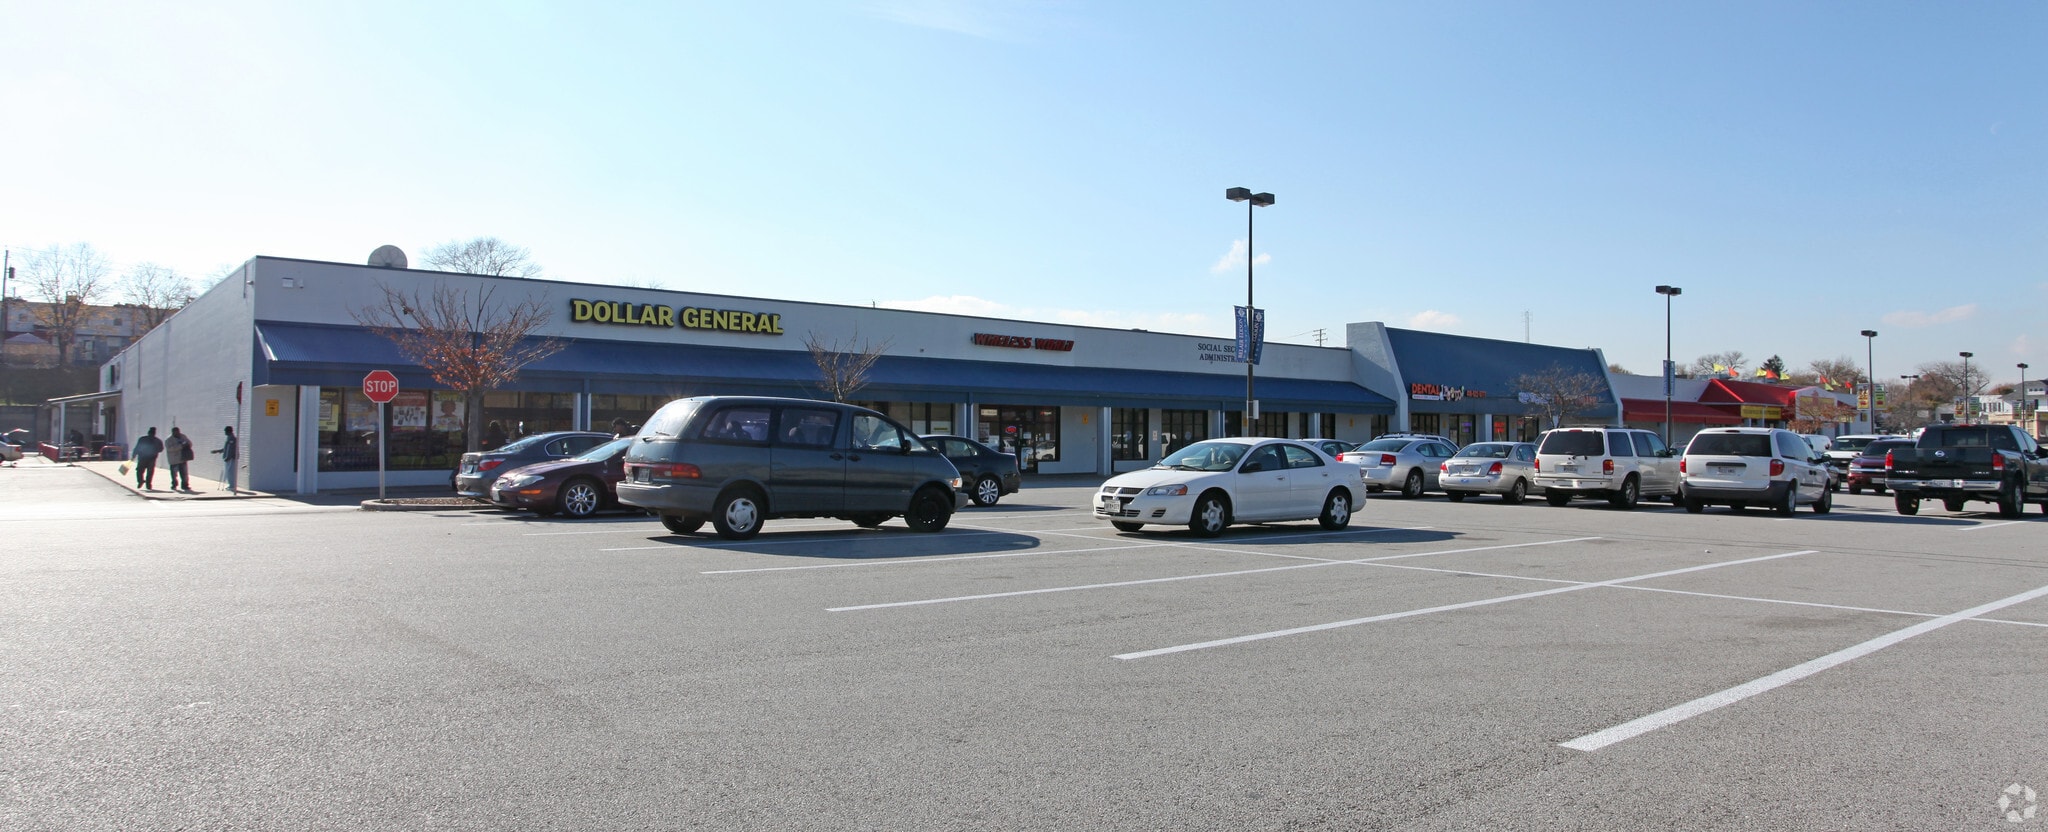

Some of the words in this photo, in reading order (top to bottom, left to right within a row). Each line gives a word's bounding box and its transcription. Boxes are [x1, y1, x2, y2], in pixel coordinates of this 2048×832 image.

[571, 300, 674, 327] DOLLAR
[681, 307, 784, 334] GENERAL
[1197, 342, 1222, 352] SOCIAL
[366, 380, 396, 392] STOP
[1411, 383, 1440, 395] DENTAL
